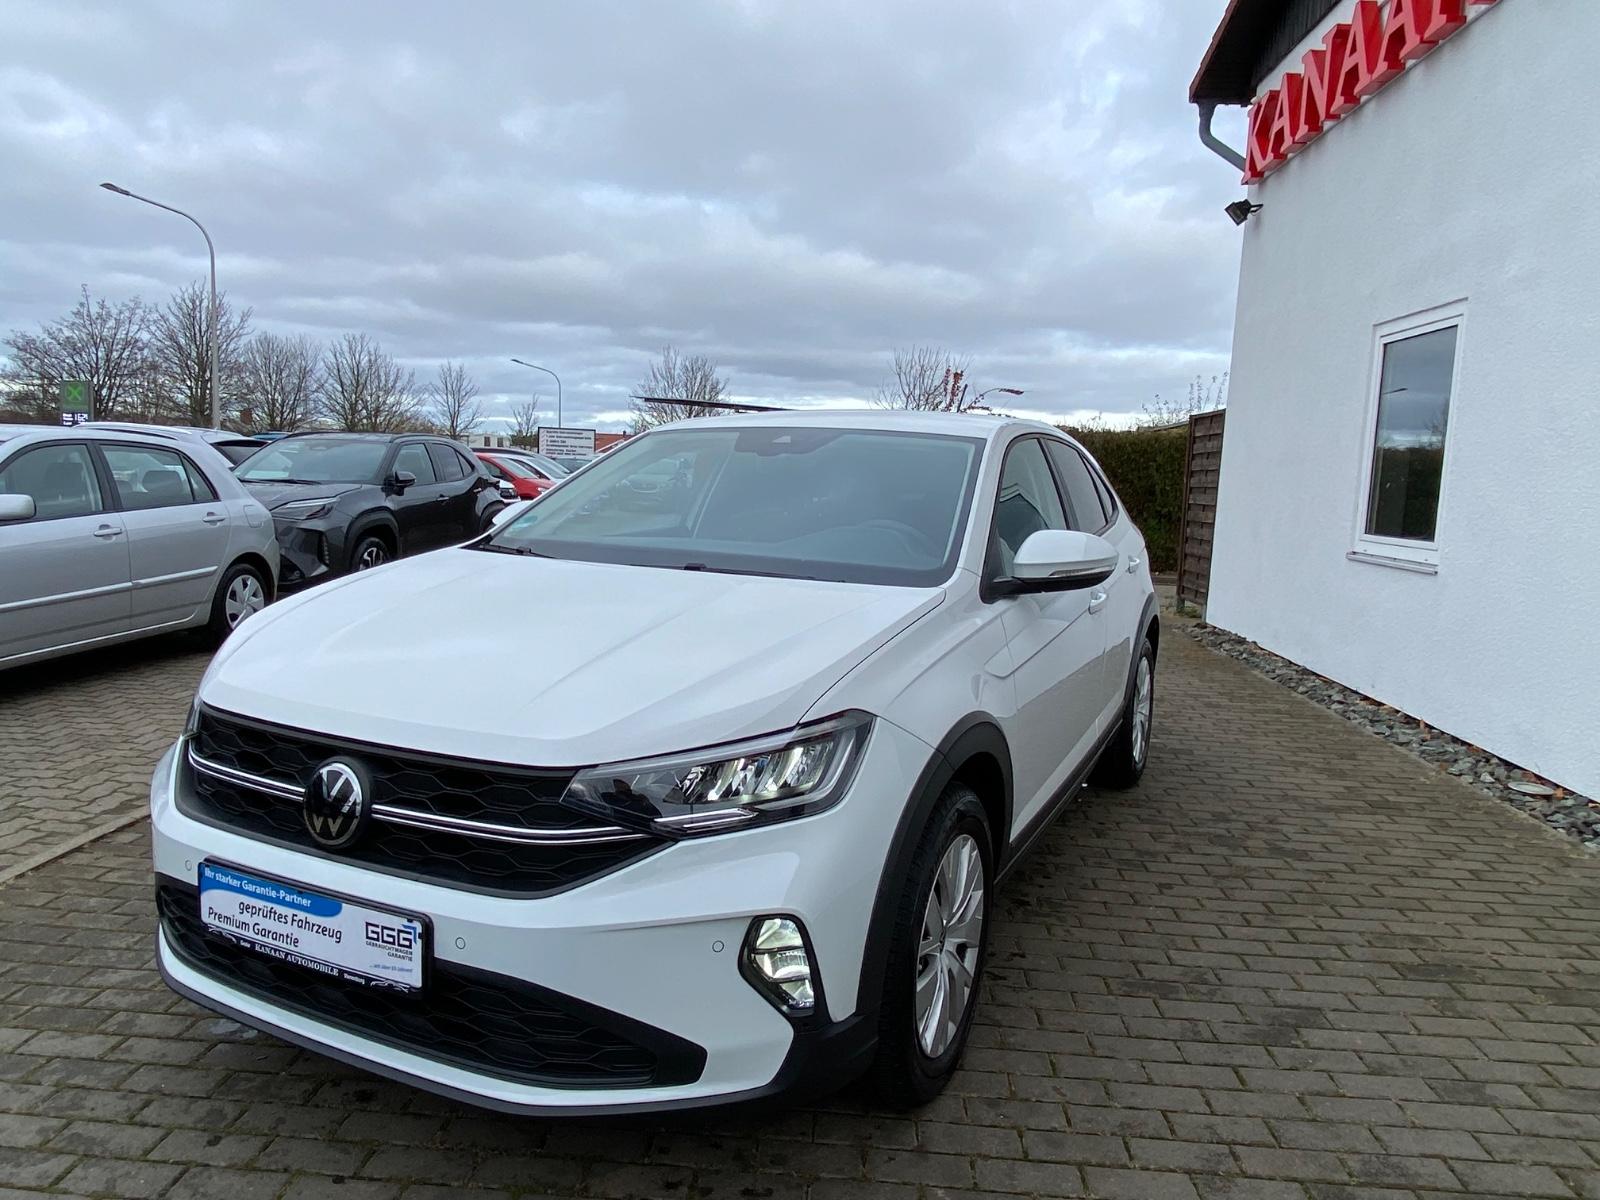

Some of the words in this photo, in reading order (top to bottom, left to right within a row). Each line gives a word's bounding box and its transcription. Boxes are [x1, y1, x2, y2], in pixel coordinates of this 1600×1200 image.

[215, 872, 242, 888] starker
[241, 880, 312, 907] Garantie-Partner
[208, 906, 251, 933] Premium
[252, 922, 300, 948] Garantie
[238, 901, 289, 925] geprüftes
[290, 913, 343, 944] Fahrzeug
[365, 921, 413, 950] GGG
[254, 944, 286, 959] KANAAN
[286, 954, 339, 977] AUTOMOBILE
[387, 952, 413, 962] GARANTIE
